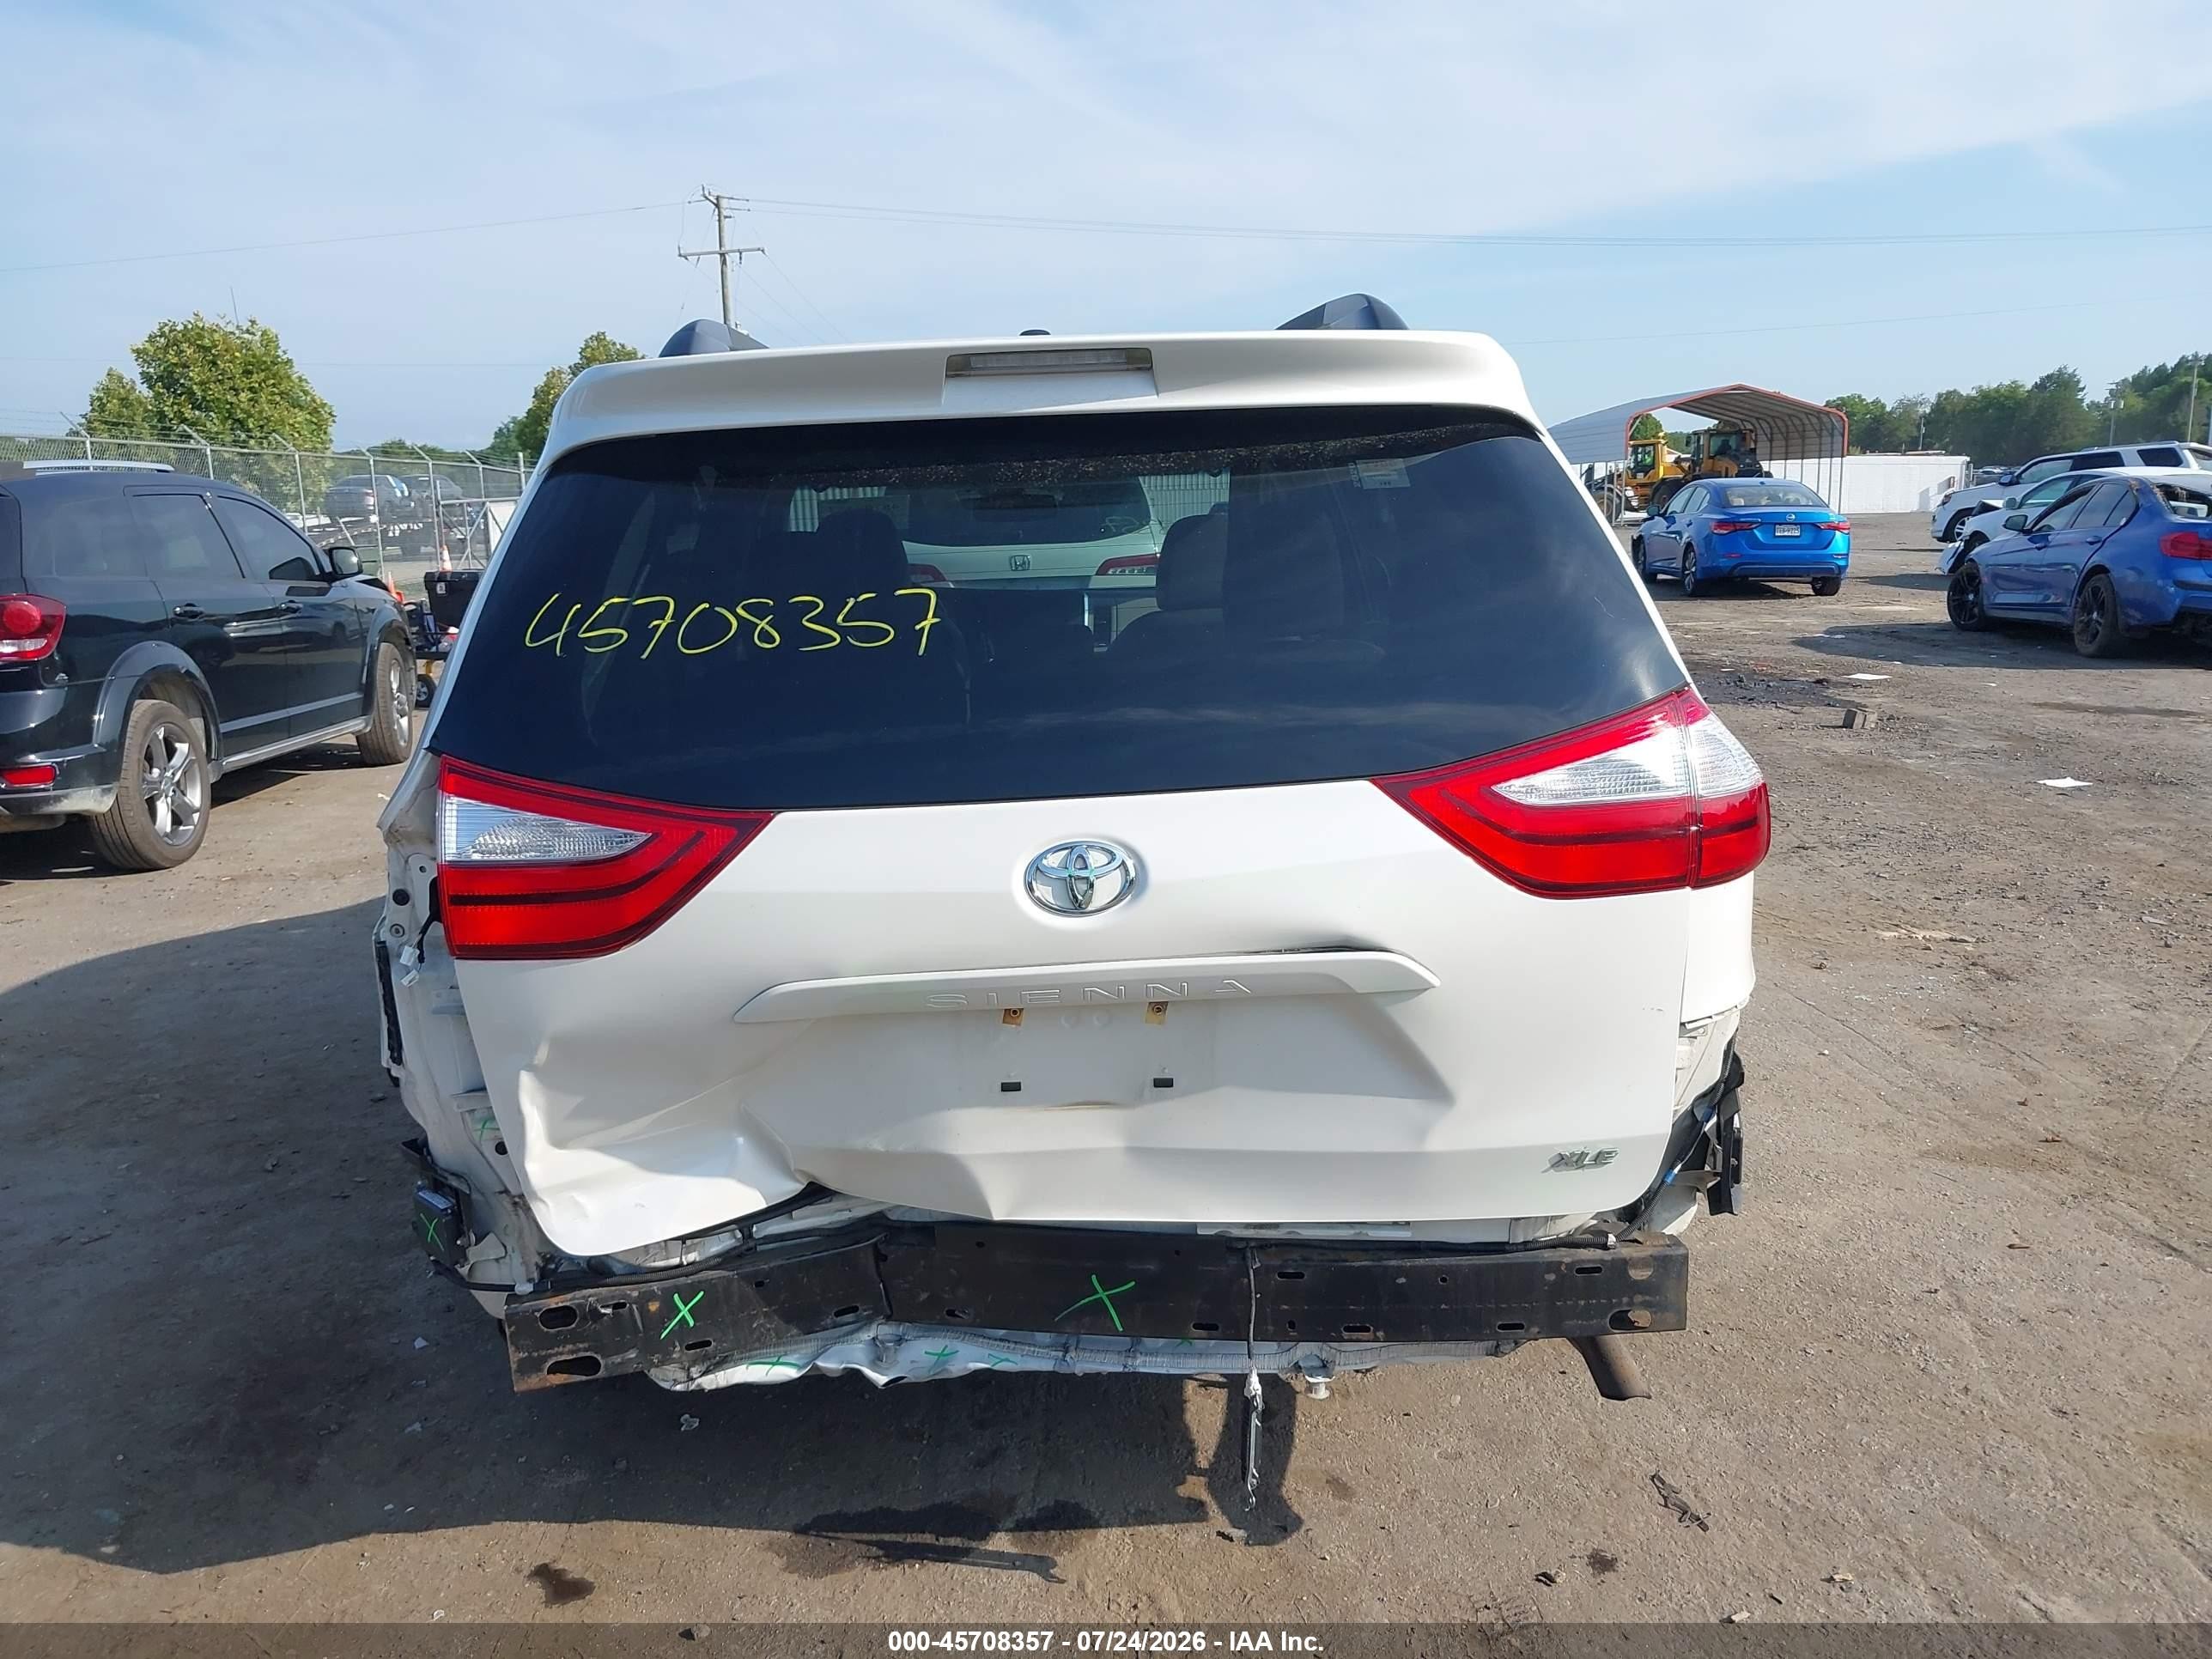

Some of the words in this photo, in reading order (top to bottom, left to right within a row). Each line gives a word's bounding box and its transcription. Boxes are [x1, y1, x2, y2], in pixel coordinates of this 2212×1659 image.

[524, 588, 942, 659] 45708357
[926, 977, 1253, 1009] SIENNA
[1544, 1147, 1619, 1171] XLE
